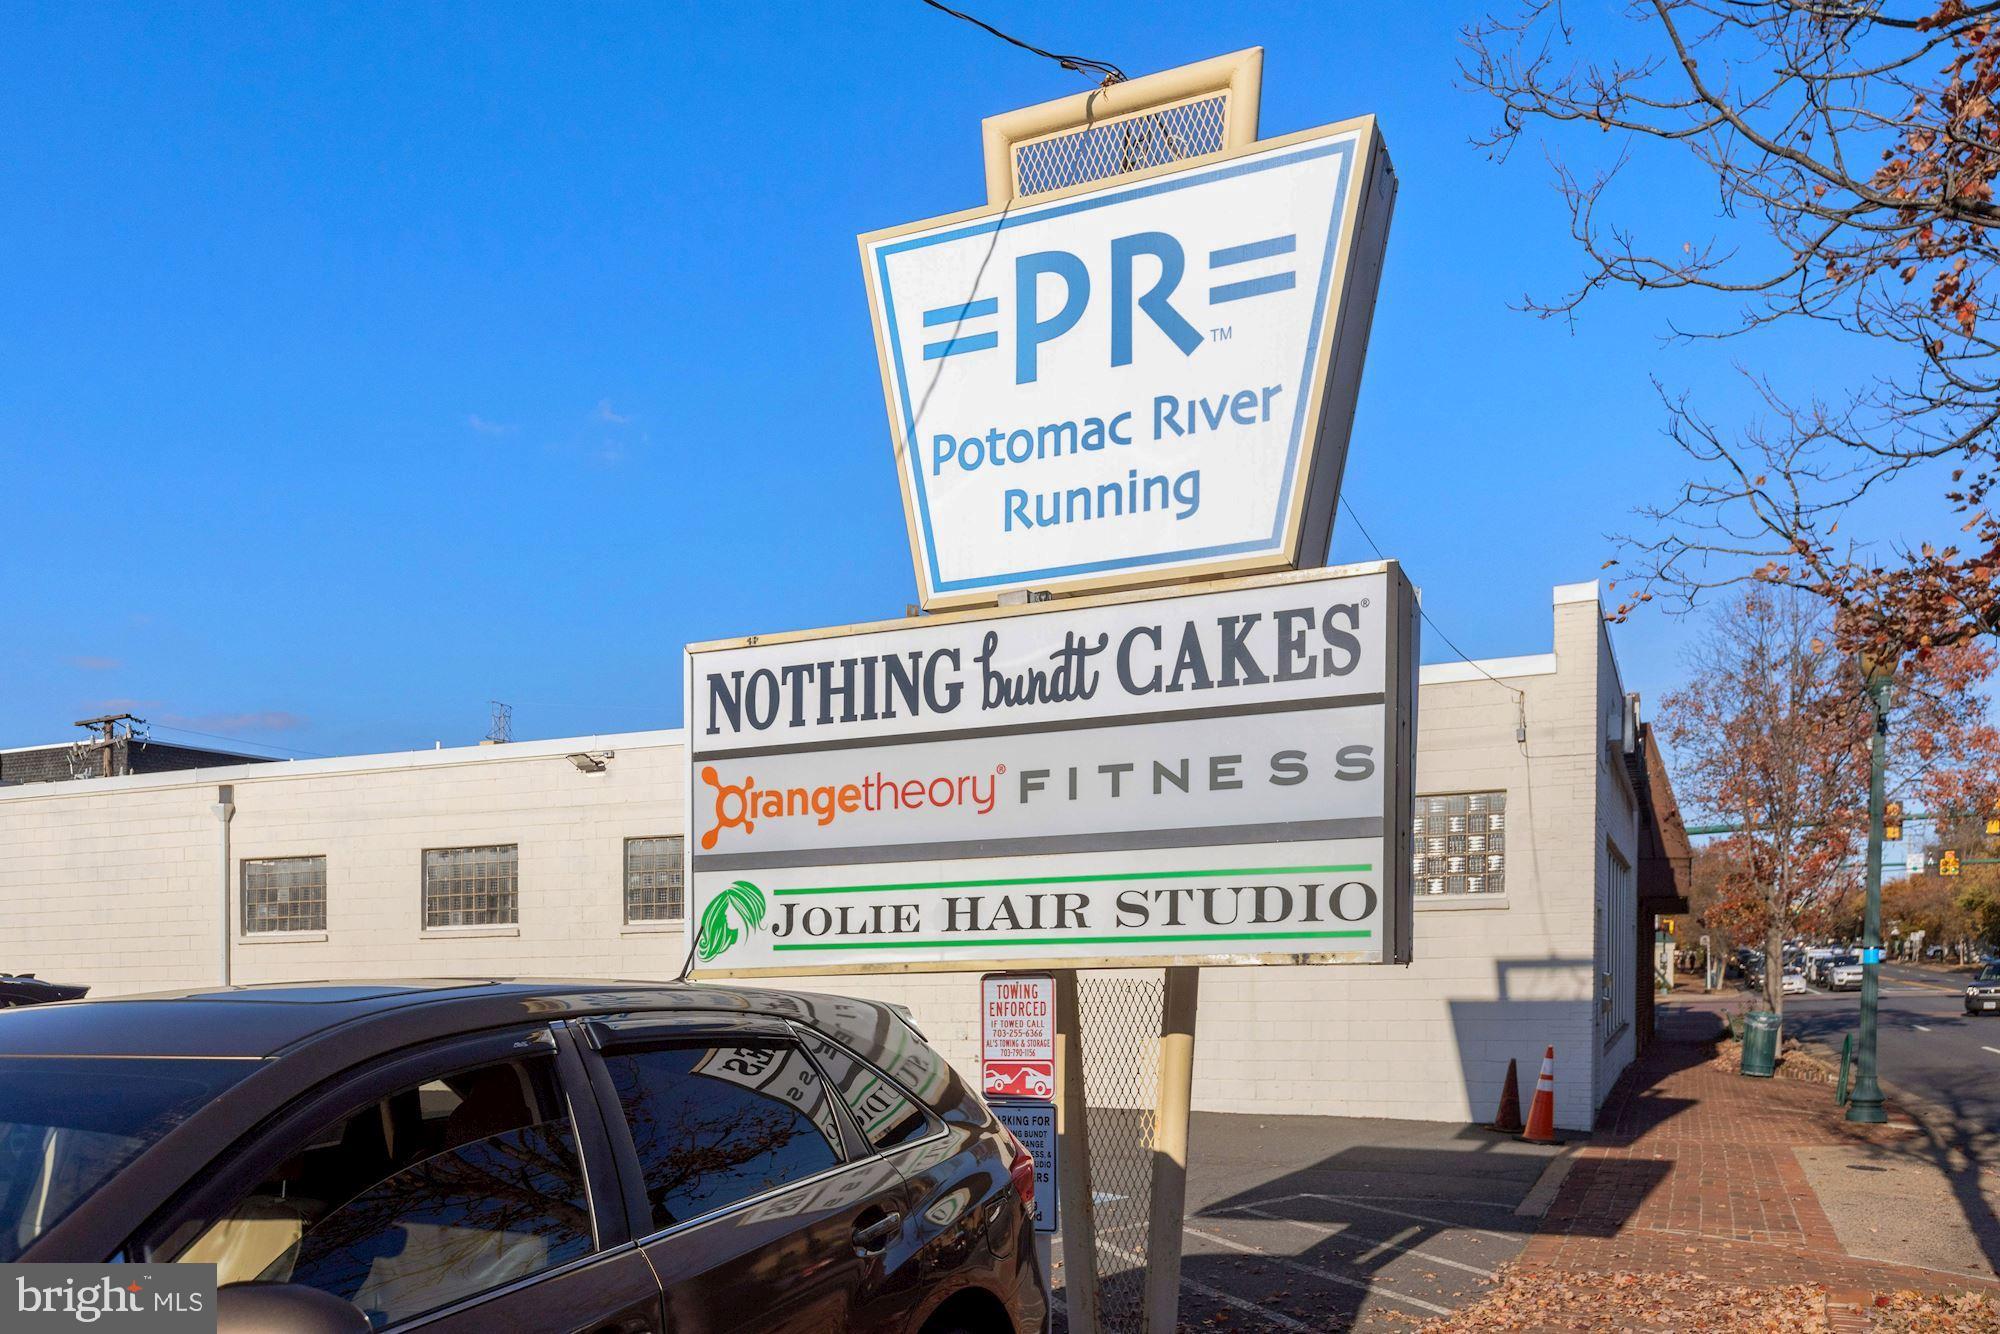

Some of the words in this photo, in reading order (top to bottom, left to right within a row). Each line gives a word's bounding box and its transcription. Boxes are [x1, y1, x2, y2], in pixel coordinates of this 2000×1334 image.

[1210, 326, 1233, 342] TM
[933, 411, 1132, 476] Potomac
[1153, 384, 1283, 440] River
[1004, 469, 1201, 532] Running
[706, 648, 964, 735] NOTHING
[973, 630, 1109, 710] bundt
[1020, 745, 1375, 804] FITNESS
[772, 903, 921, 937] JOLIE
[941, 893, 1092, 932] HAIR
[1116, 882, 1377, 928] STUDIO
[990, 1002, 1046, 1016] ENFORCED
[997, 984, 1038, 999] TOWING
[991, 1020, 997, 1028] IF
[1001, 1020, 1023, 1028] TOWED
[1027, 1020, 1044, 1028] CALL
[1032, 1116, 1050, 1126] FOR
